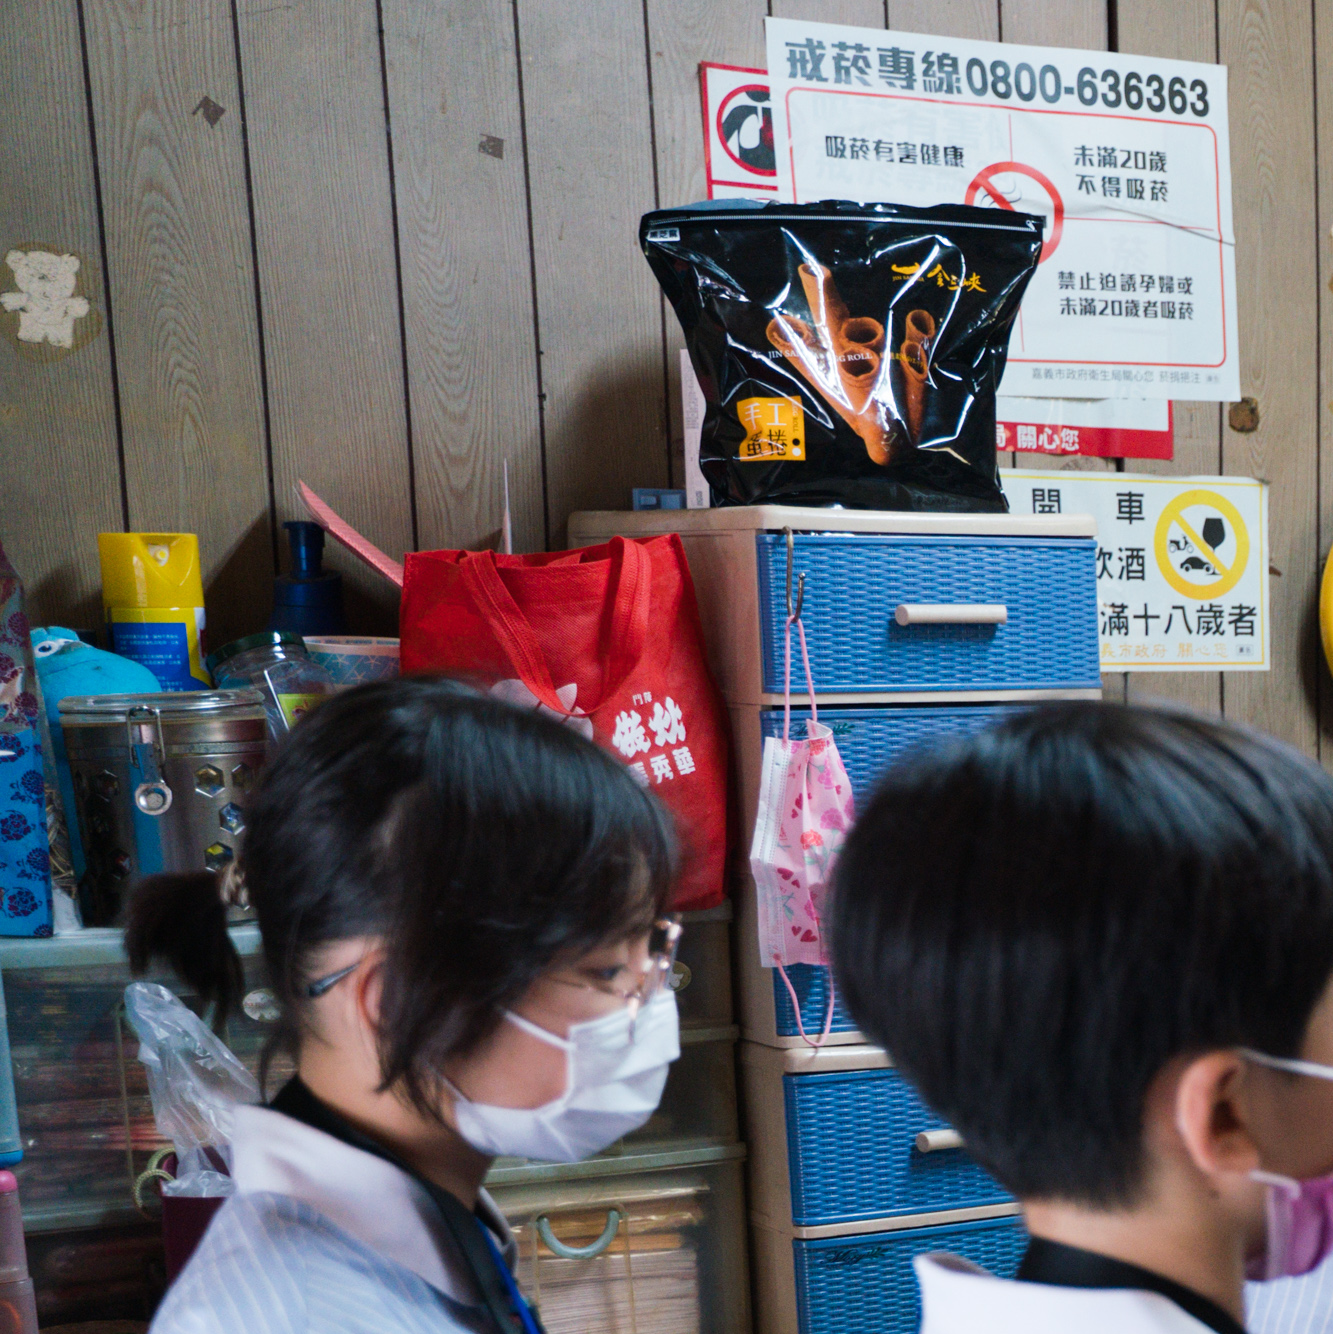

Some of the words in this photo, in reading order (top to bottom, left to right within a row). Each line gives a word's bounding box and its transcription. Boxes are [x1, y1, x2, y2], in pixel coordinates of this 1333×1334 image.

[785, 37, 1210, 118] 戒菸專線0800-636363
[825, 135, 965, 168] 吸菸有害健康
[1073, 145, 1168, 173] 未滿20歲
[1075, 174, 1169, 202] 不得吸菸
[1058, 271, 1194, 296] 禁止迫誘孕婦或
[1060, 297, 1194, 320] 未滿20歲者吸菸
[768, 351, 783, 359] JIN
[847, 352, 873, 361] ROLL
[1032, 368, 1154, 383] 嘉義市政府衛生局關心您
[744, 402, 787, 430] 手工
[1017, 426, 1080, 451] 關心您
